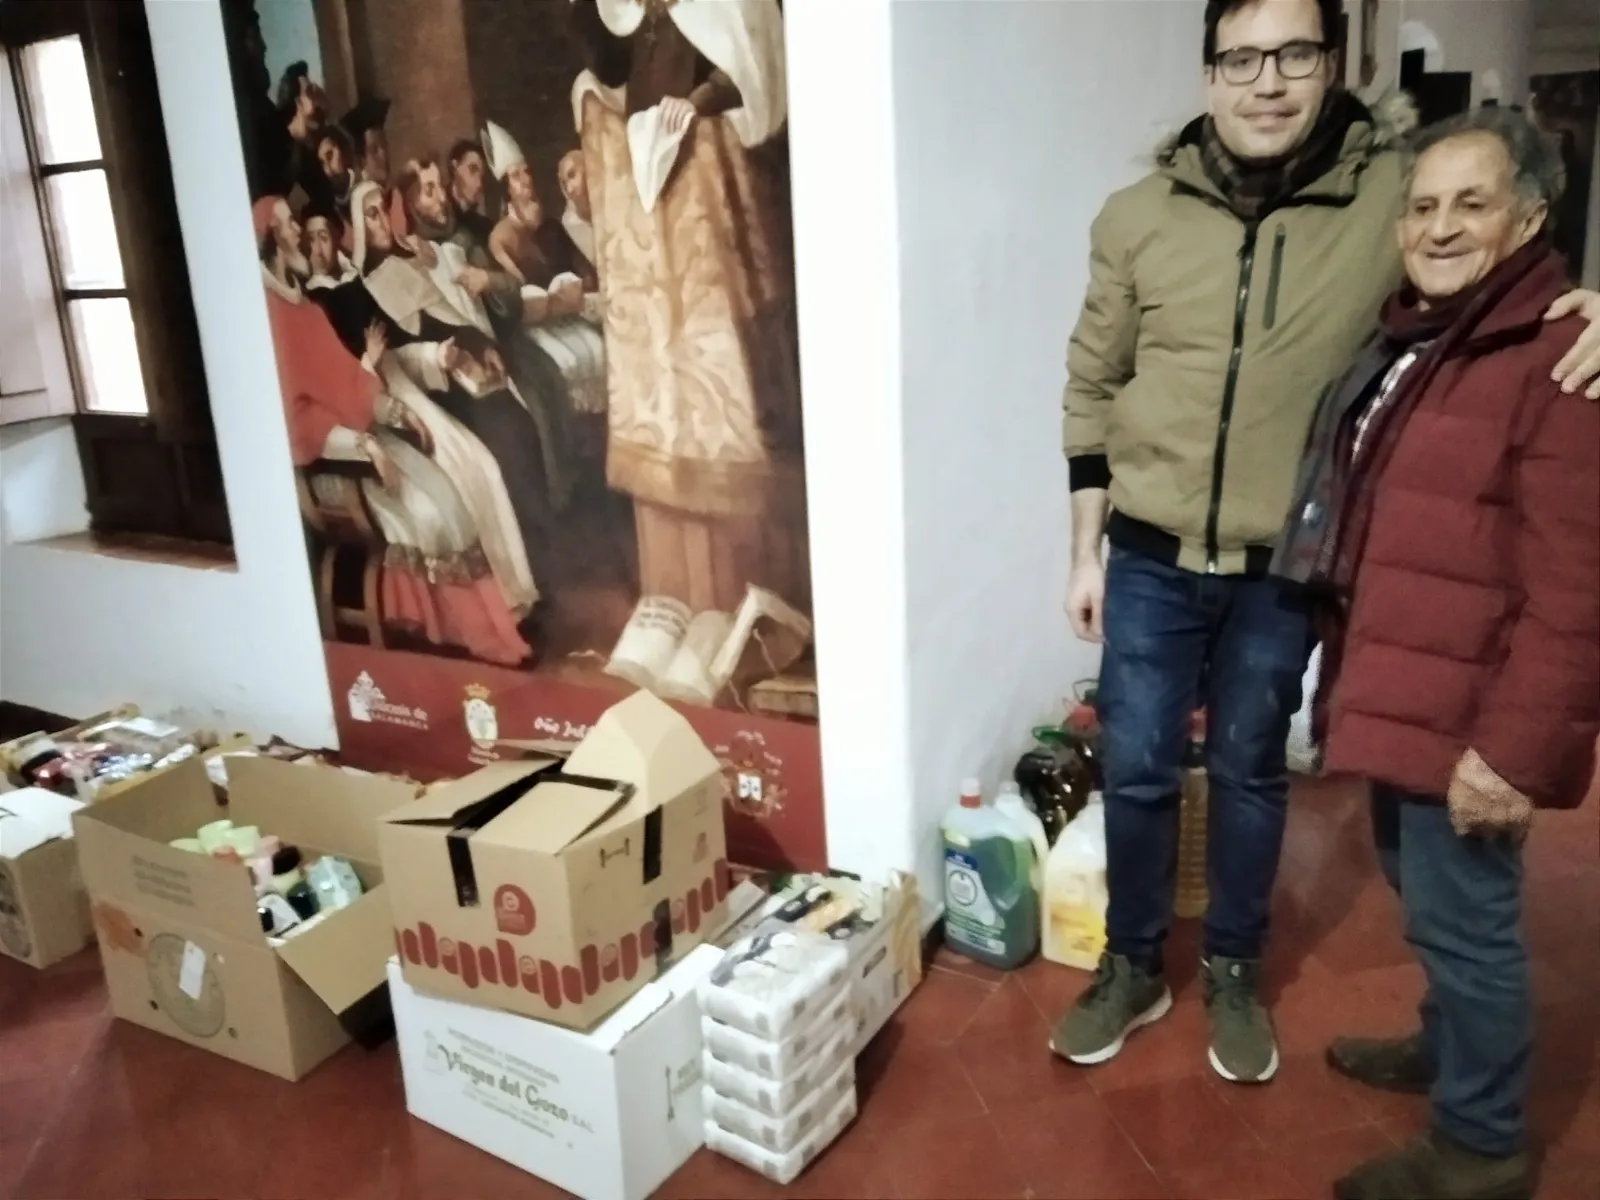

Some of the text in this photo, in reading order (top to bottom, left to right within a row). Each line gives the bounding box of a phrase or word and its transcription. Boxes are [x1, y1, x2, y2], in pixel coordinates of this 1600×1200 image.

[437, 1043, 496, 1086] Virgen
[499, 1074, 522, 1099] del
[525, 1084, 569, 1122] Gozo
